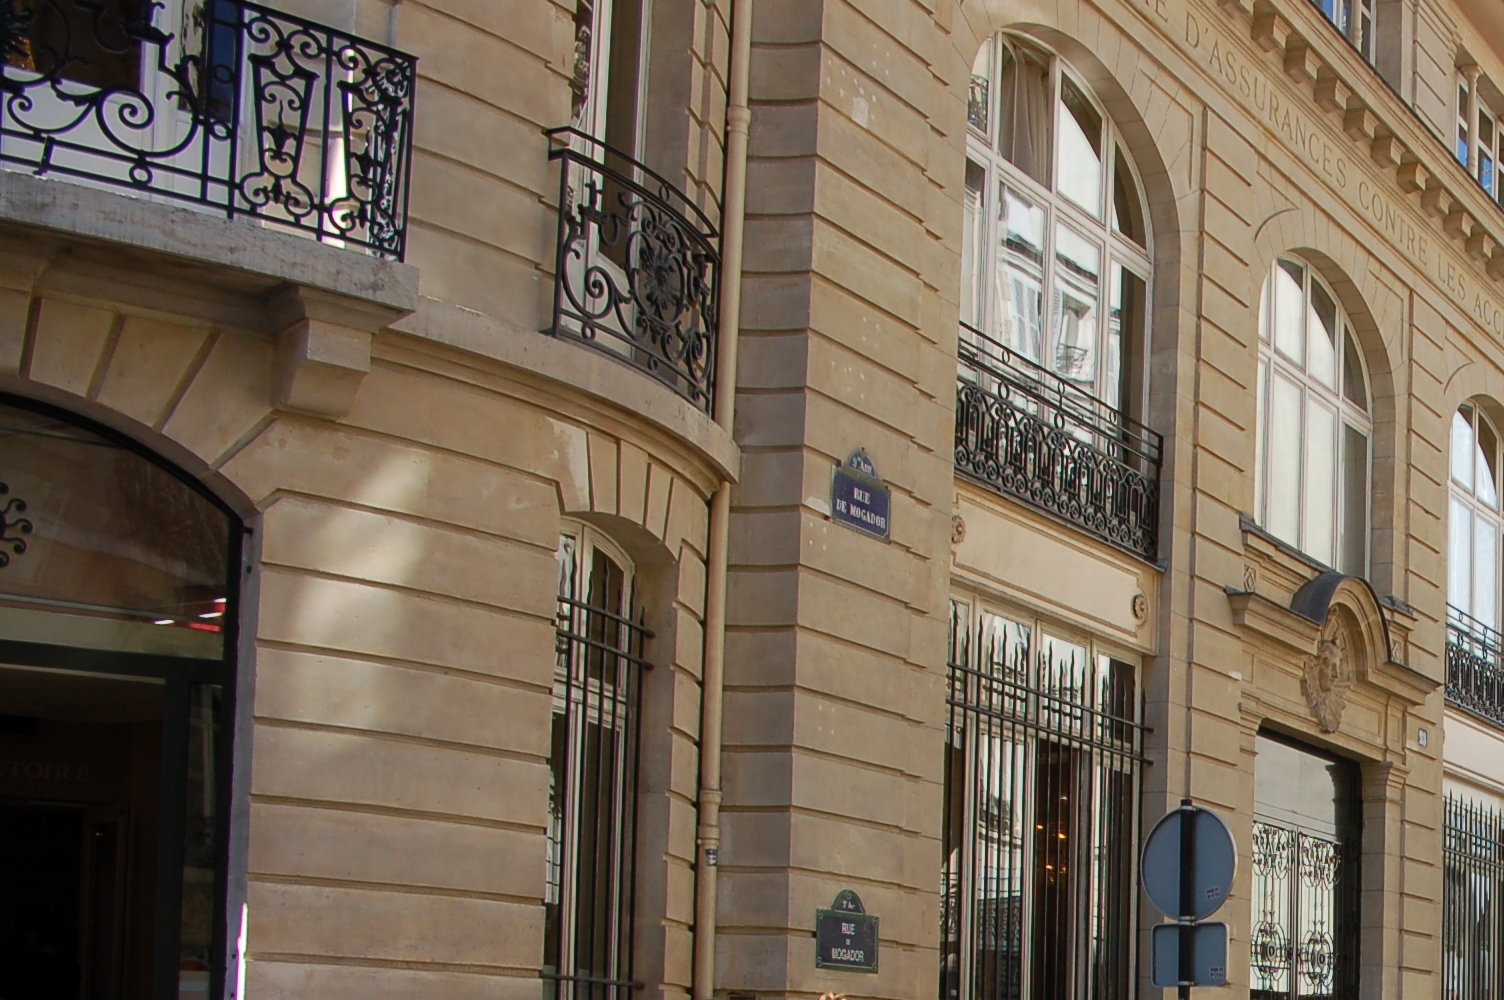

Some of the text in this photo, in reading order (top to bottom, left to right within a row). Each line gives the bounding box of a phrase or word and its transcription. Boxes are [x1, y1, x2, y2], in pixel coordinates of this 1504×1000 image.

[1185, 11, 1347, 189] D'ASSURANCES
[1358, 181, 1428, 267] CONTRE
[1437, 253, 1466, 301] LES
[853, 487, 871, 505] RUE
[836, 498, 886, 529] DE MOGADOR
[0, 758, 90, 782] TOIRE
[841, 922, 855, 935] RUE
[831, 947, 865, 962] MOGADOR
